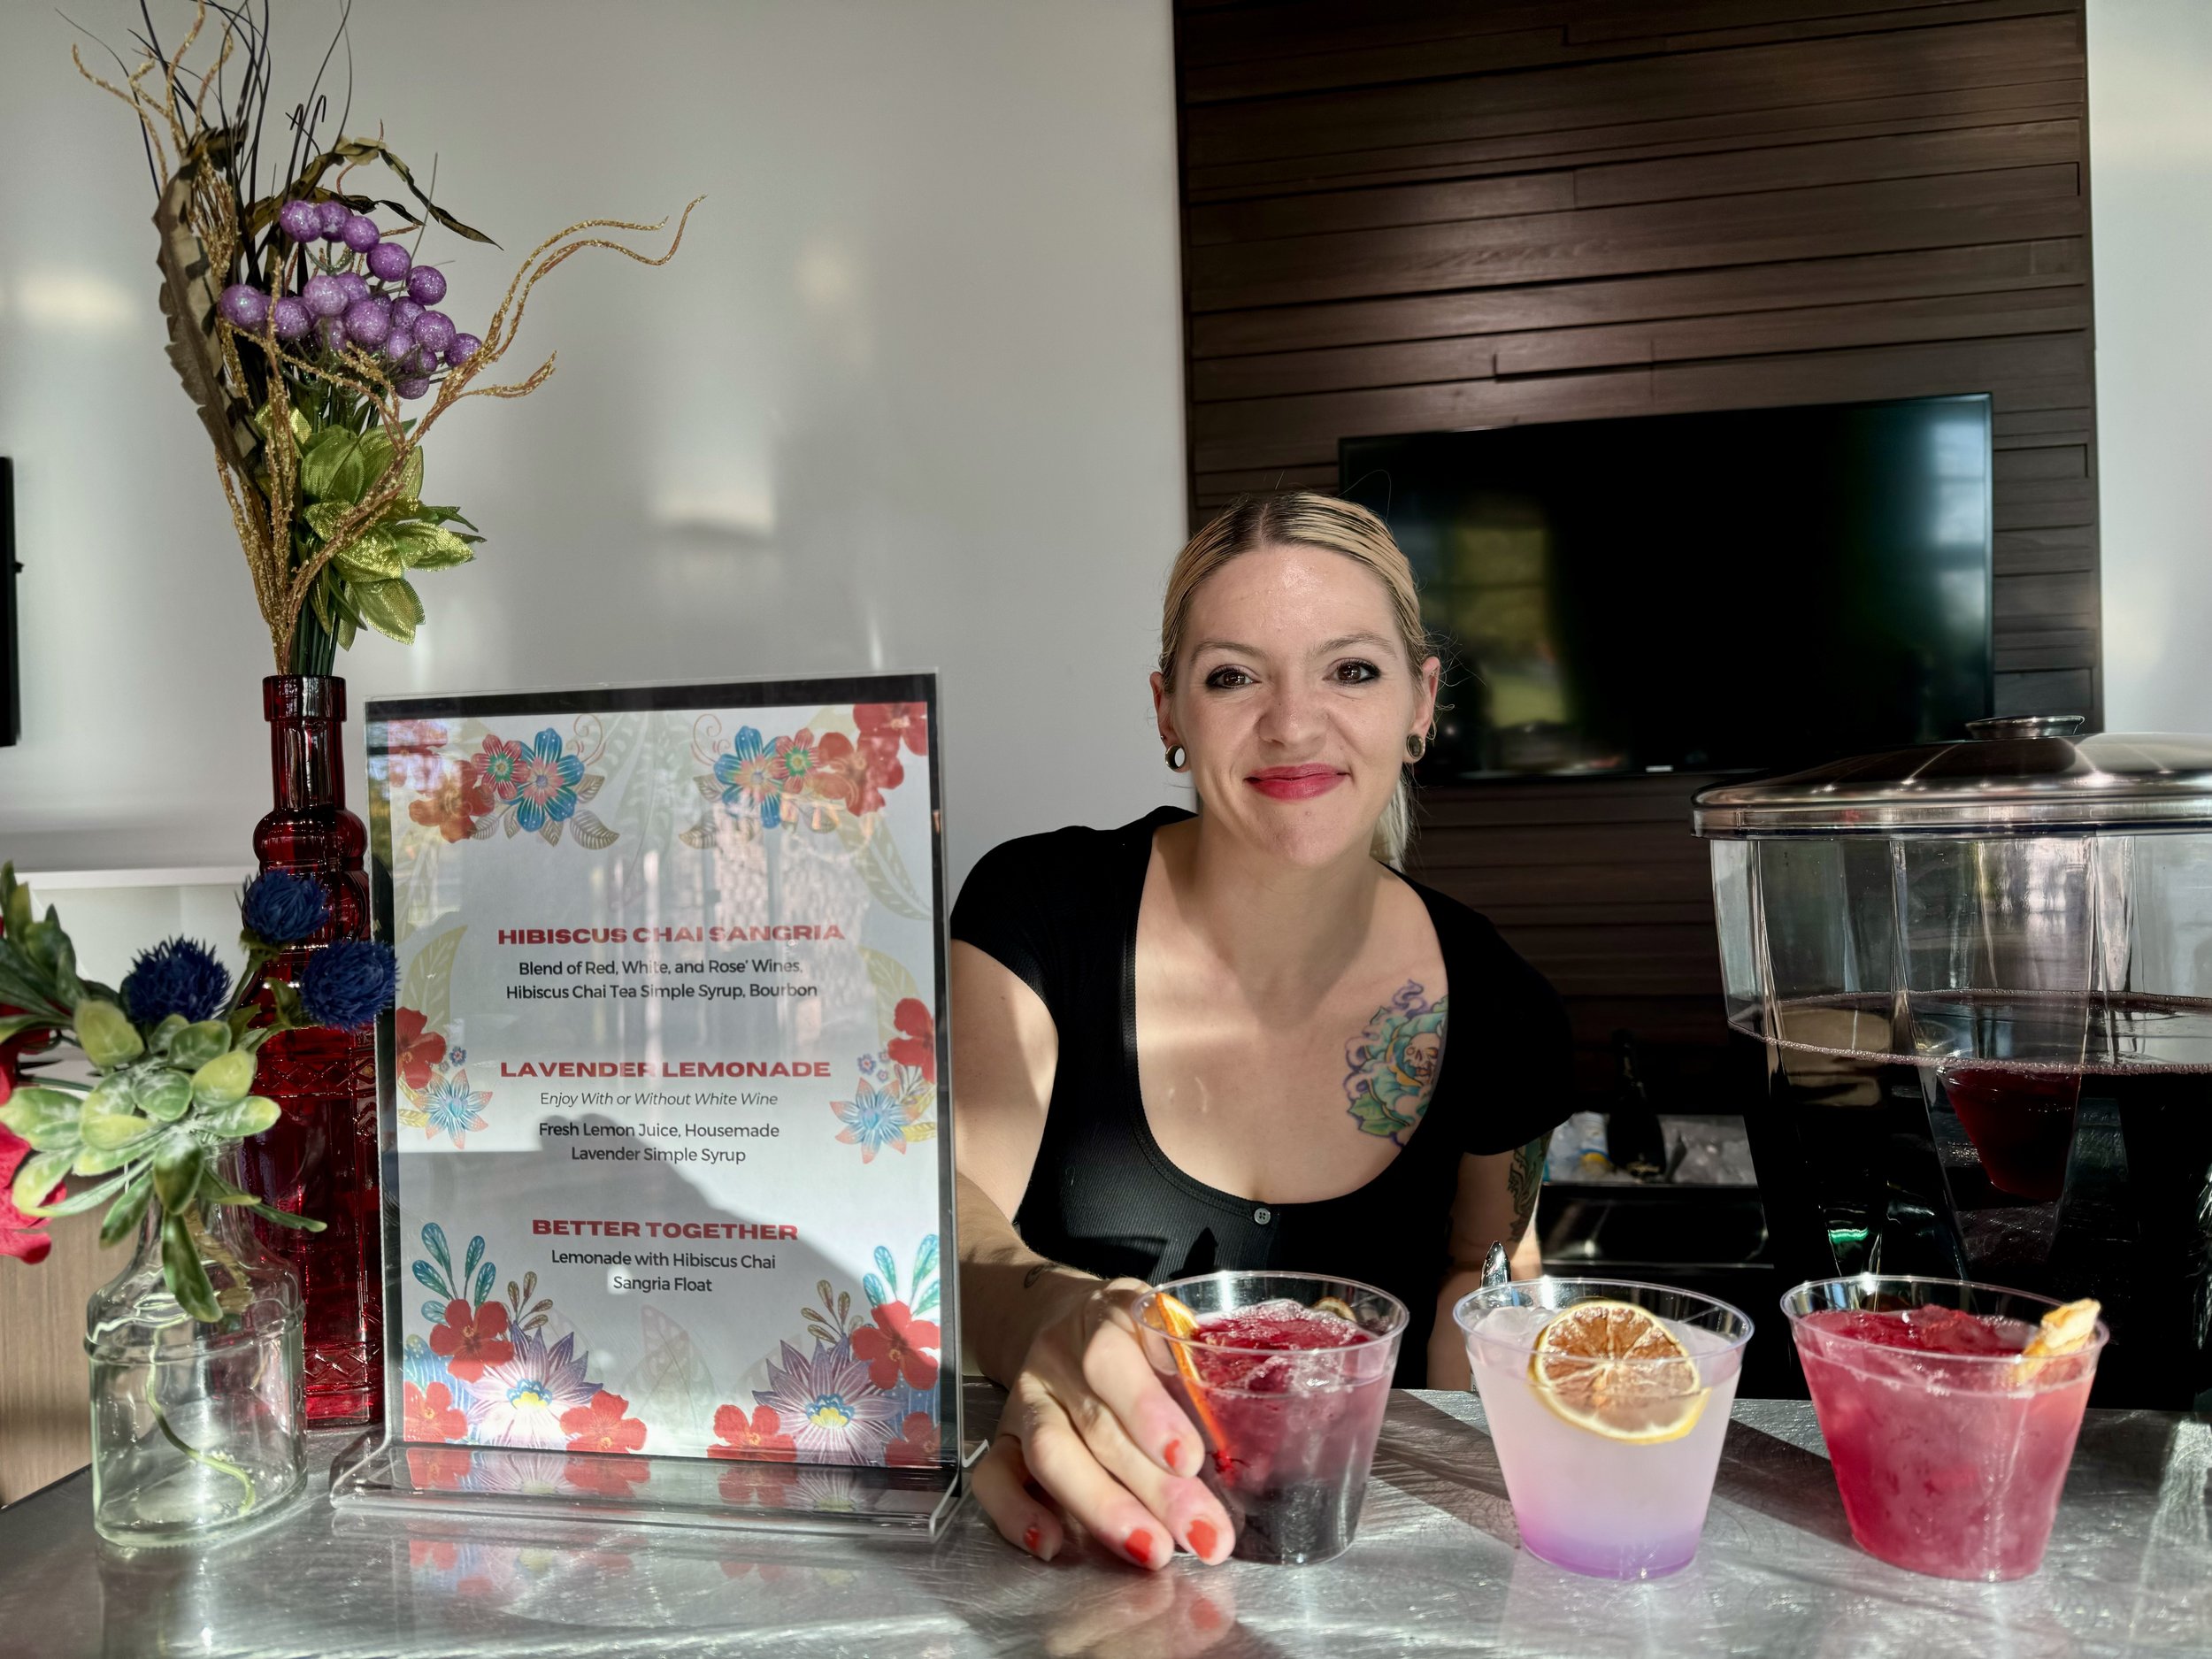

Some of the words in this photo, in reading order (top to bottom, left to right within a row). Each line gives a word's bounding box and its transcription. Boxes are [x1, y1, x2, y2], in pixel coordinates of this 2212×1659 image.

[498, 927, 627, 944] HIBISCUS
[633, 926, 703, 942] CHAI
[709, 925, 845, 941] SANGRIA
[519, 962, 563, 976] Blend
[566, 961, 582, 974] of
[586, 961, 618, 976] Red,
[622, 960, 671, 976] White,
[675, 960, 703, 973] and
[506, 986, 569, 1000] Hibiscus
[572, 985, 606, 999] Chai
[610, 985, 637, 998] Tea
[641, 984, 695, 1002] Simple
[698, 984, 746, 1001] Syrup,
[749, 984, 818, 997] Bourbon
[663, 1062, 831, 1077] LEMONADE
[541, 1093, 578, 1108] Enjoy
[581, 1093, 613, 1105] With
[617, 1095, 633, 1105] or
[634, 1092, 691, 1105] Without
[695, 1092, 737, 1105] White
[741, 1093, 778, 1105] Wine
[539, 1123, 580, 1137] Fresh
[583, 1123, 635, 1137] Lemon
[639, 1124, 681, 1139] Juice,
[685, 1124, 780, 1138] Housemade
[572, 1147, 641, 1161] Lavender
[643, 1148, 698, 1164] Simple
[701, 1148, 746, 1165] Syrup
[533, 1220, 641, 1236] BETTER
[645, 1222, 798, 1240] TOGETHER
[552, 1250, 632, 1266] Lemonade
[634, 1251, 670, 1266] with
[672, 1254, 738, 1268] Hibiscus
[741, 1255, 776, 1269] Chai
[613, 1276, 670, 1294] Sangria
[674, 1278, 712, 1292] Float
